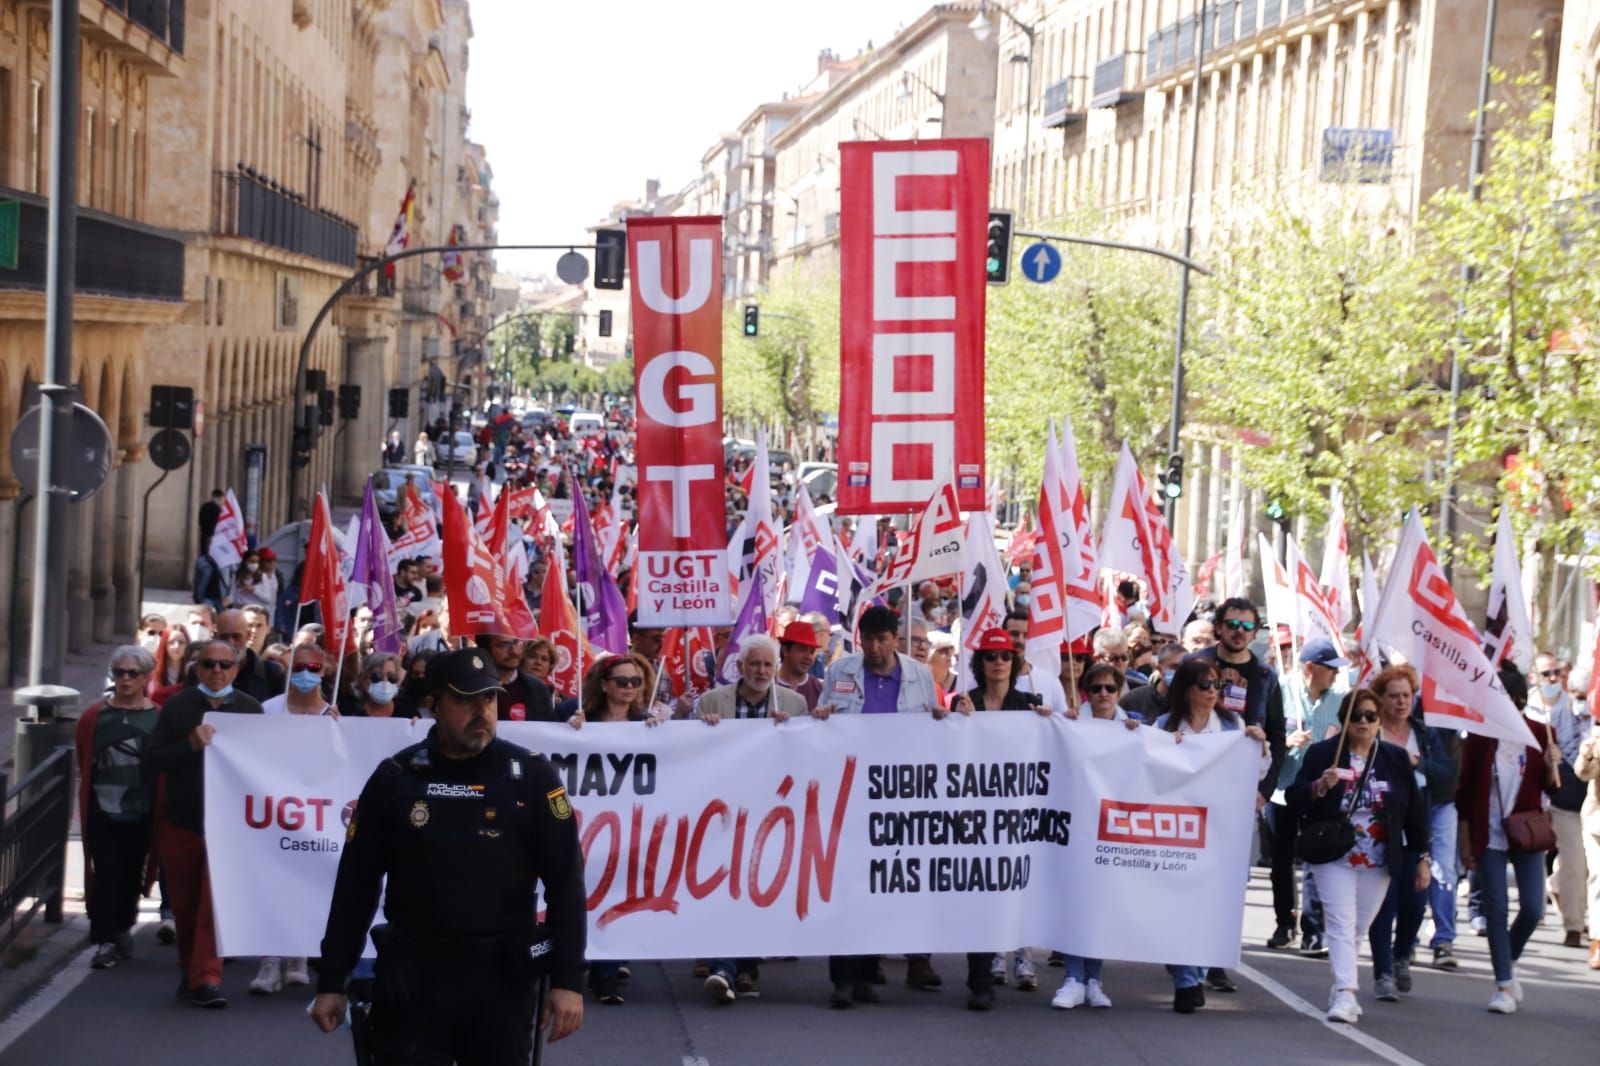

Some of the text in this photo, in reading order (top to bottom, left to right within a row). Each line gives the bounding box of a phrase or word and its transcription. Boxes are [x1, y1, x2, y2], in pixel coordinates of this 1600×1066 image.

[870, 150, 959, 503] CCOO
[636, 239, 718, 540] UGT
[647, 554, 718, 580] UGT
[647, 579, 720, 594] Castilla
[654, 595, 716, 613] y León
[1411, 619, 1485, 683] Castilla y
[551, 752, 657, 797] MAYO
[868, 761, 1050, 800] SUBIR SALARIOS
[427, 789, 484, 797] NACIONAL
[244, 795, 333, 831] UGT
[869, 807, 1072, 846] CONTENER PRECIOS
[1106, 808, 1200, 840] CCOO
[279, 836, 339, 853] Castilla
[576, 754, 857, 930] OLUCIÓN
[1096, 844, 1198, 861] comisiones obreras
[870, 849, 1031, 894] MÁS IGUALDAD
[1095, 855, 1188, 872] de Castilla y León
